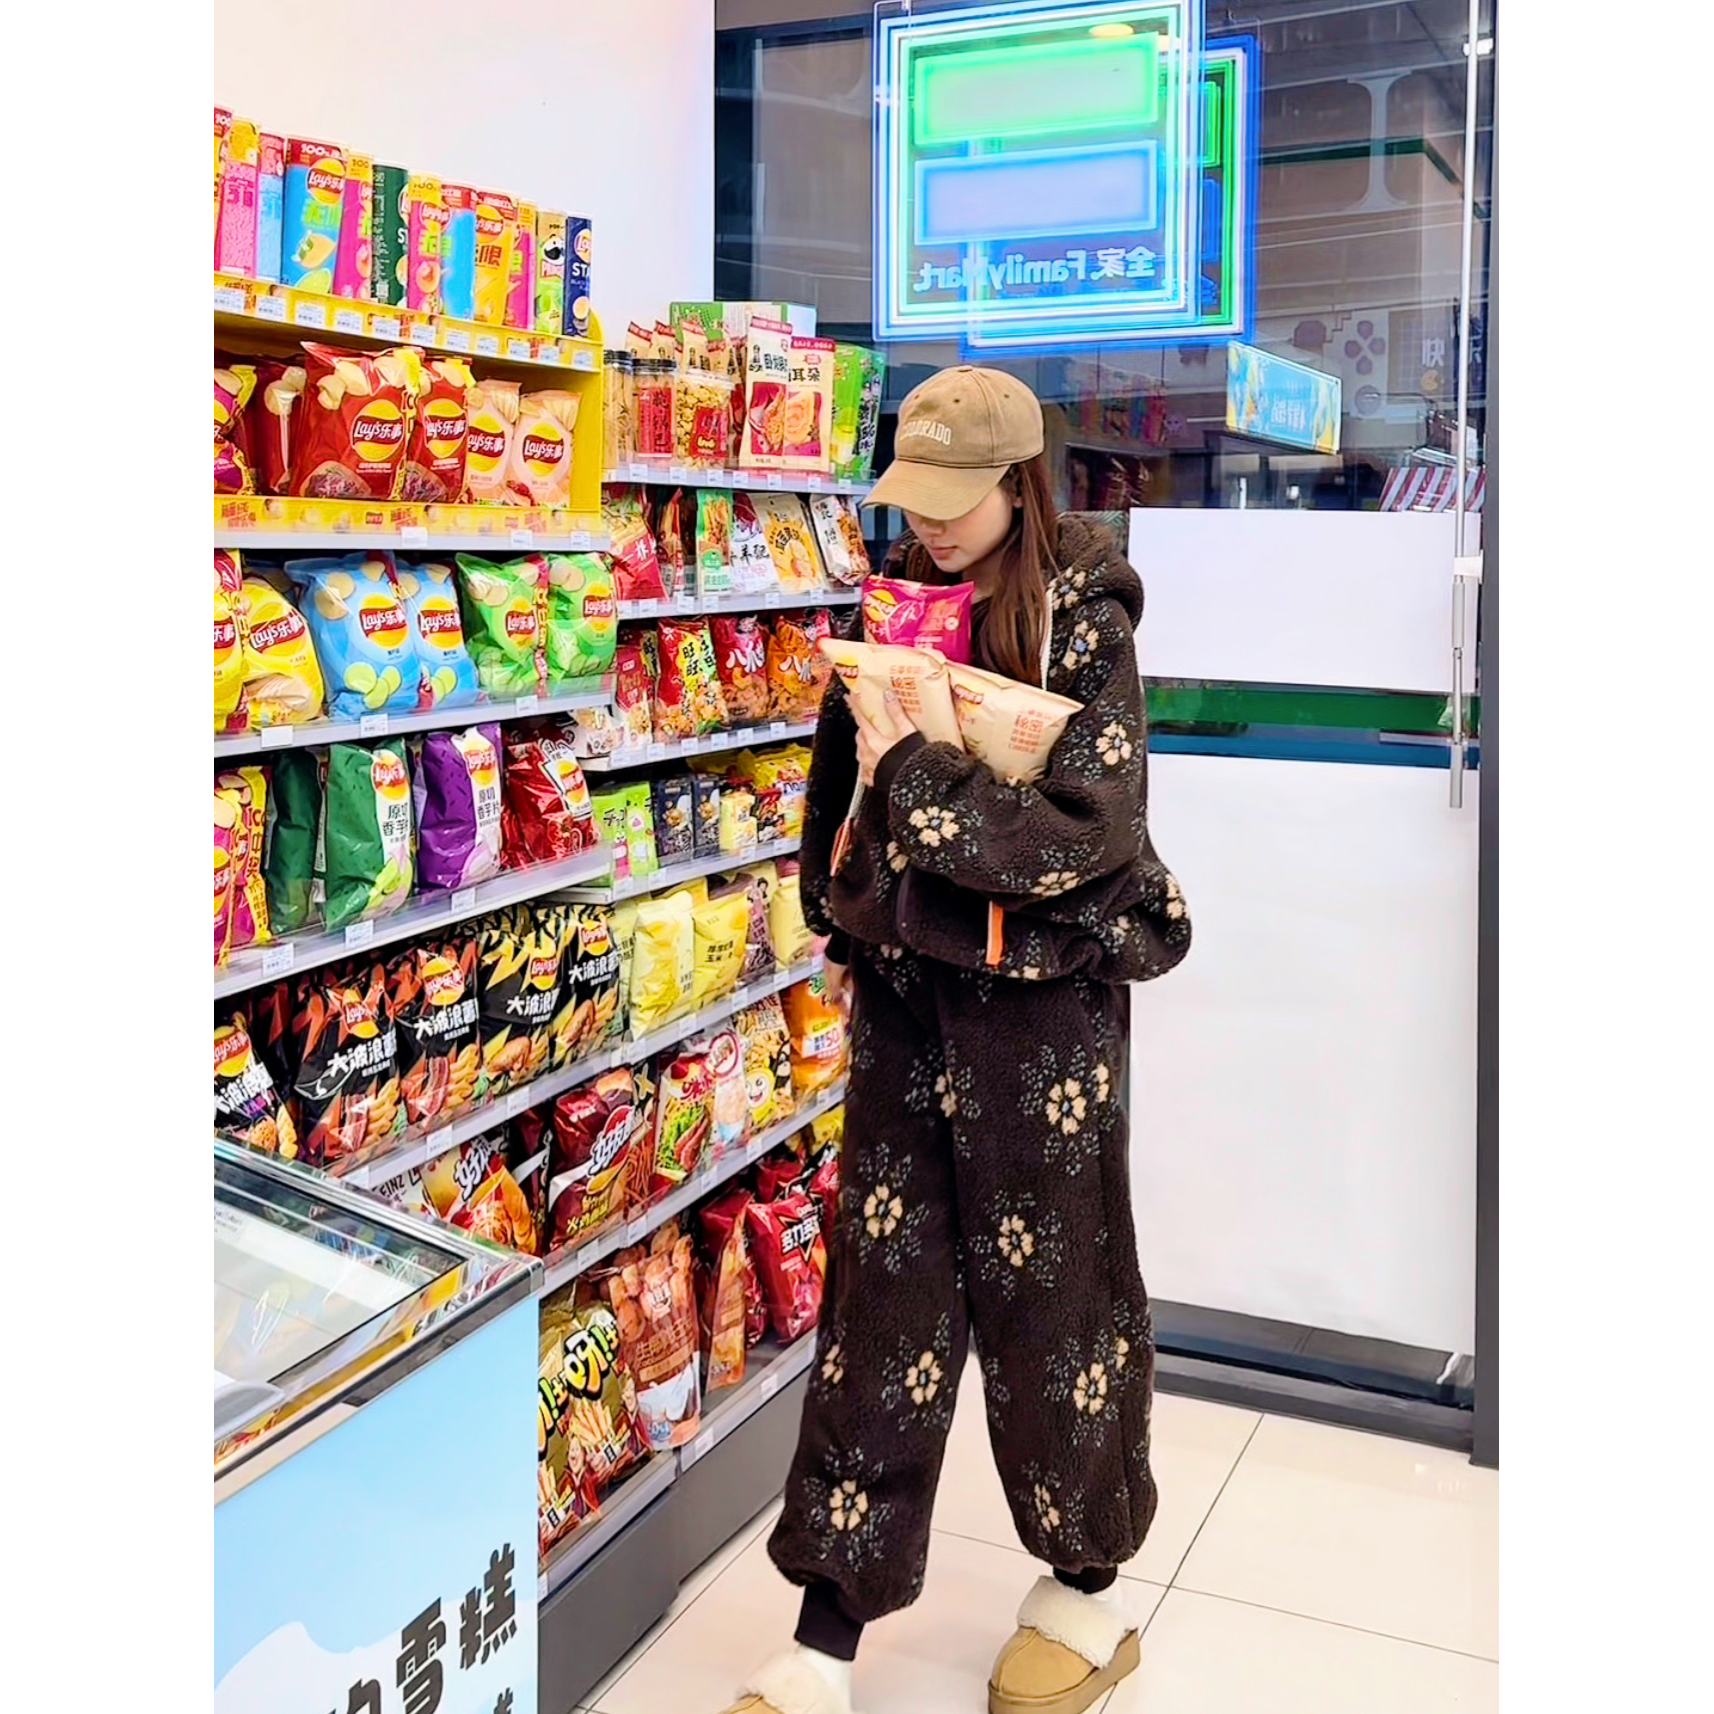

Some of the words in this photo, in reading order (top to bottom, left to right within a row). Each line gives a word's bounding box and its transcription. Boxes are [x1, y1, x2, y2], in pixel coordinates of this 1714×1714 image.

[506, 988, 560, 1017] 大波浪
[372, 1174, 405, 1196] EINZ
[328, 1542, 518, 1714] 雪糕
